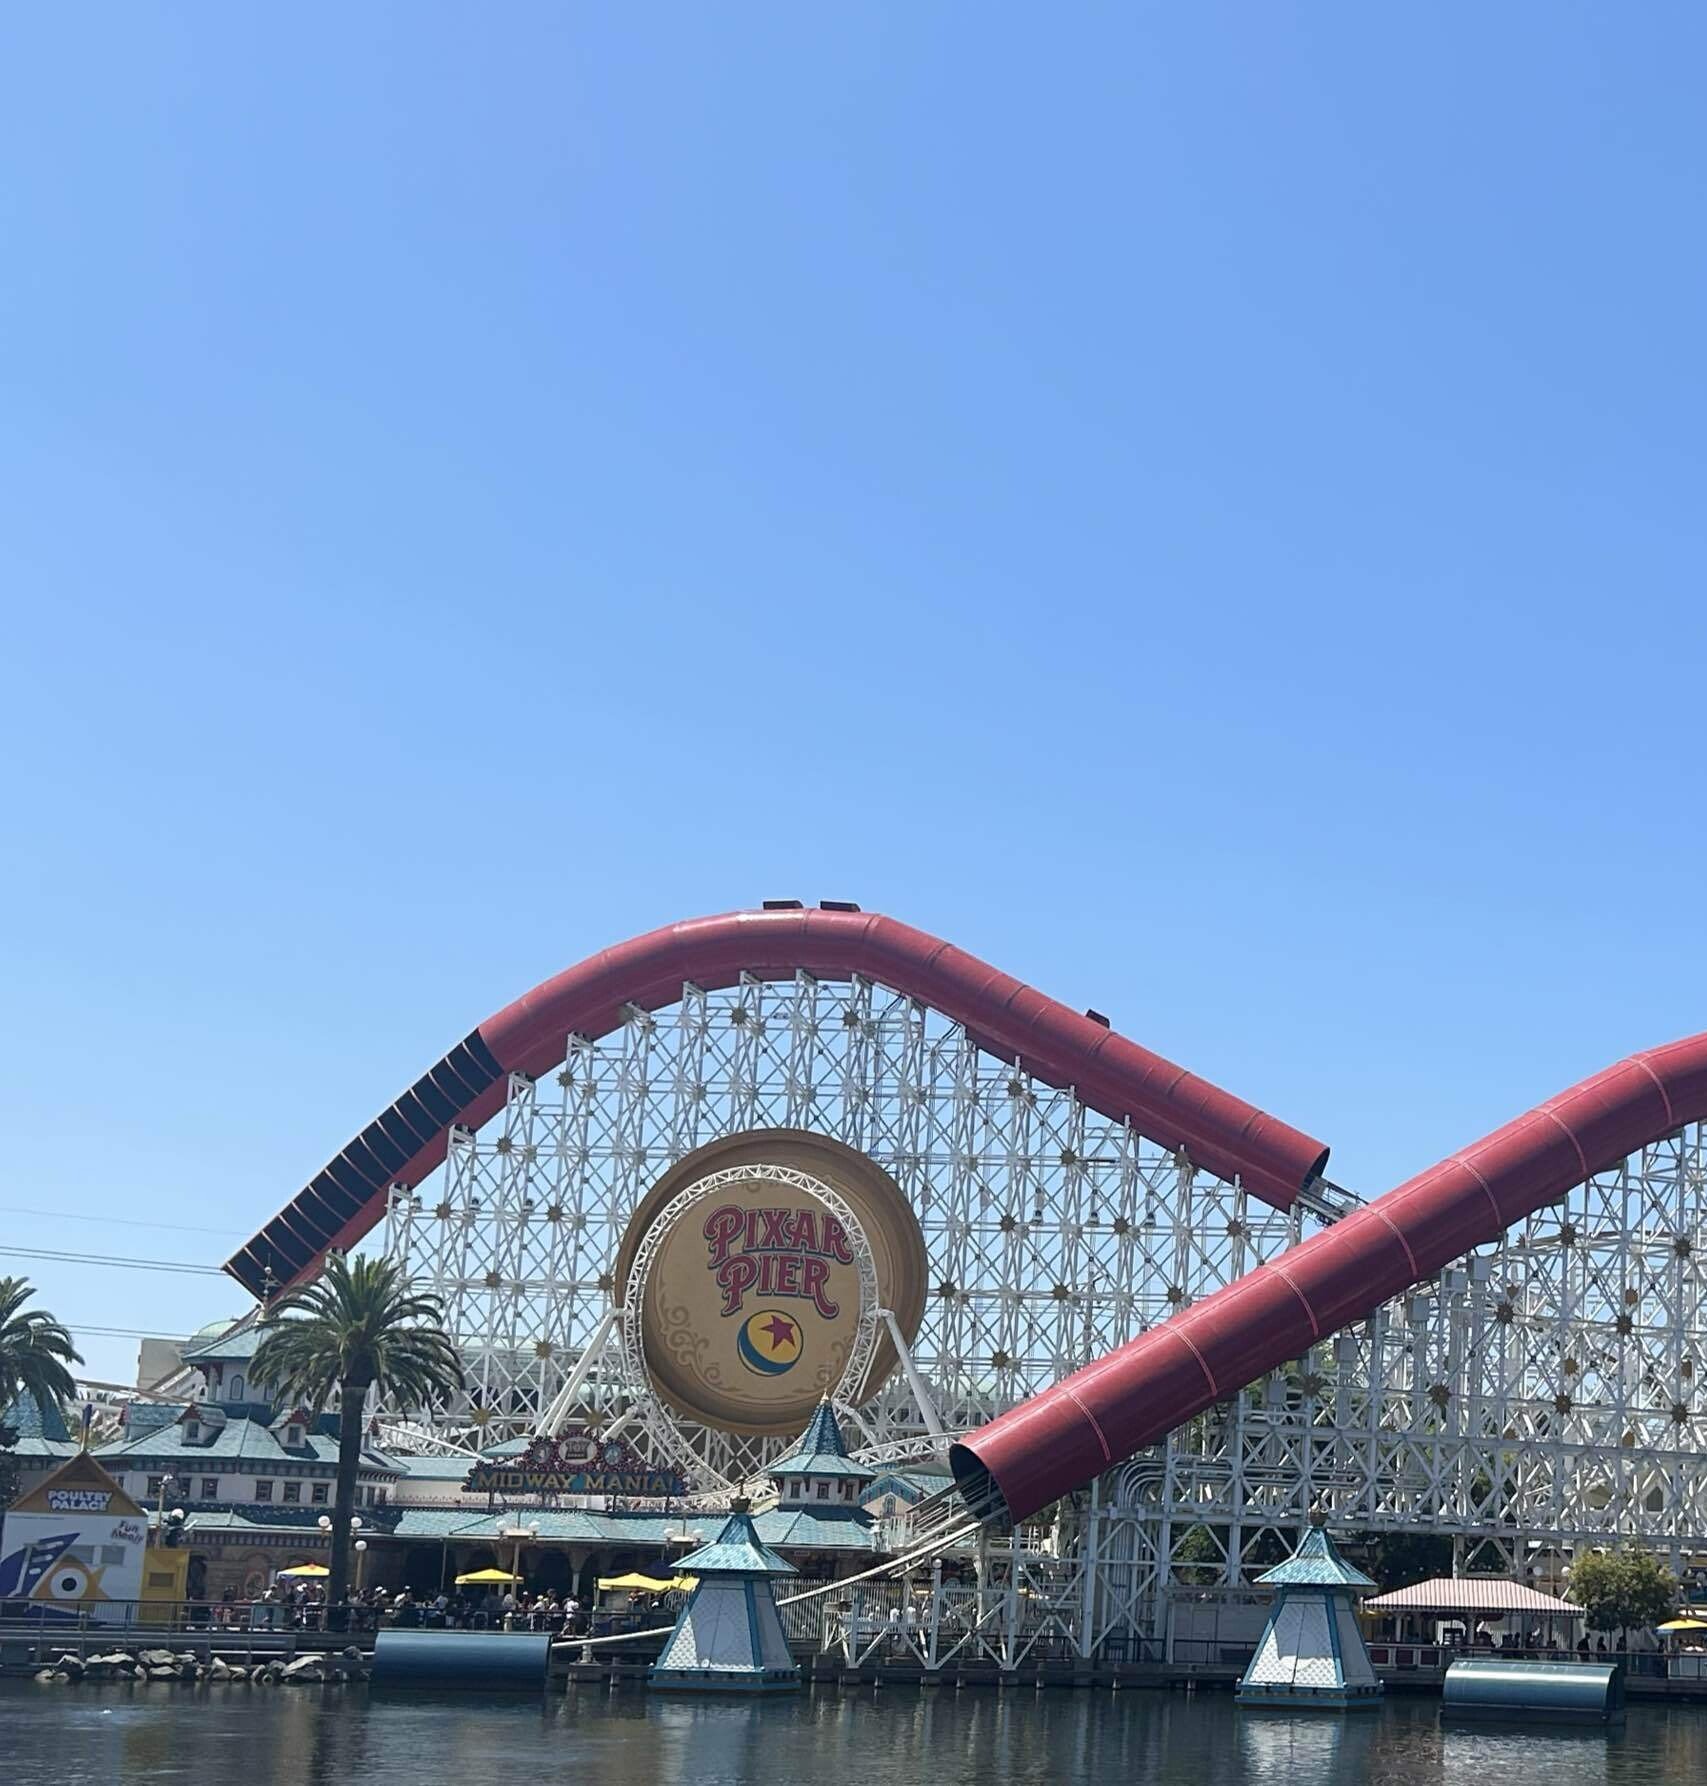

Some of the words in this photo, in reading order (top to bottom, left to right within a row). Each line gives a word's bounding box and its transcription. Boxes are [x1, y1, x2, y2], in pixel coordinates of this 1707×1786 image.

[704, 1204, 854, 1269] PIXAR
[717, 1252, 839, 1319] PIER
[477, 1472, 577, 1488] MIDWAY
[584, 1472, 673, 1491] MANIA!
[51, 1500, 107, 1510] PALACE
